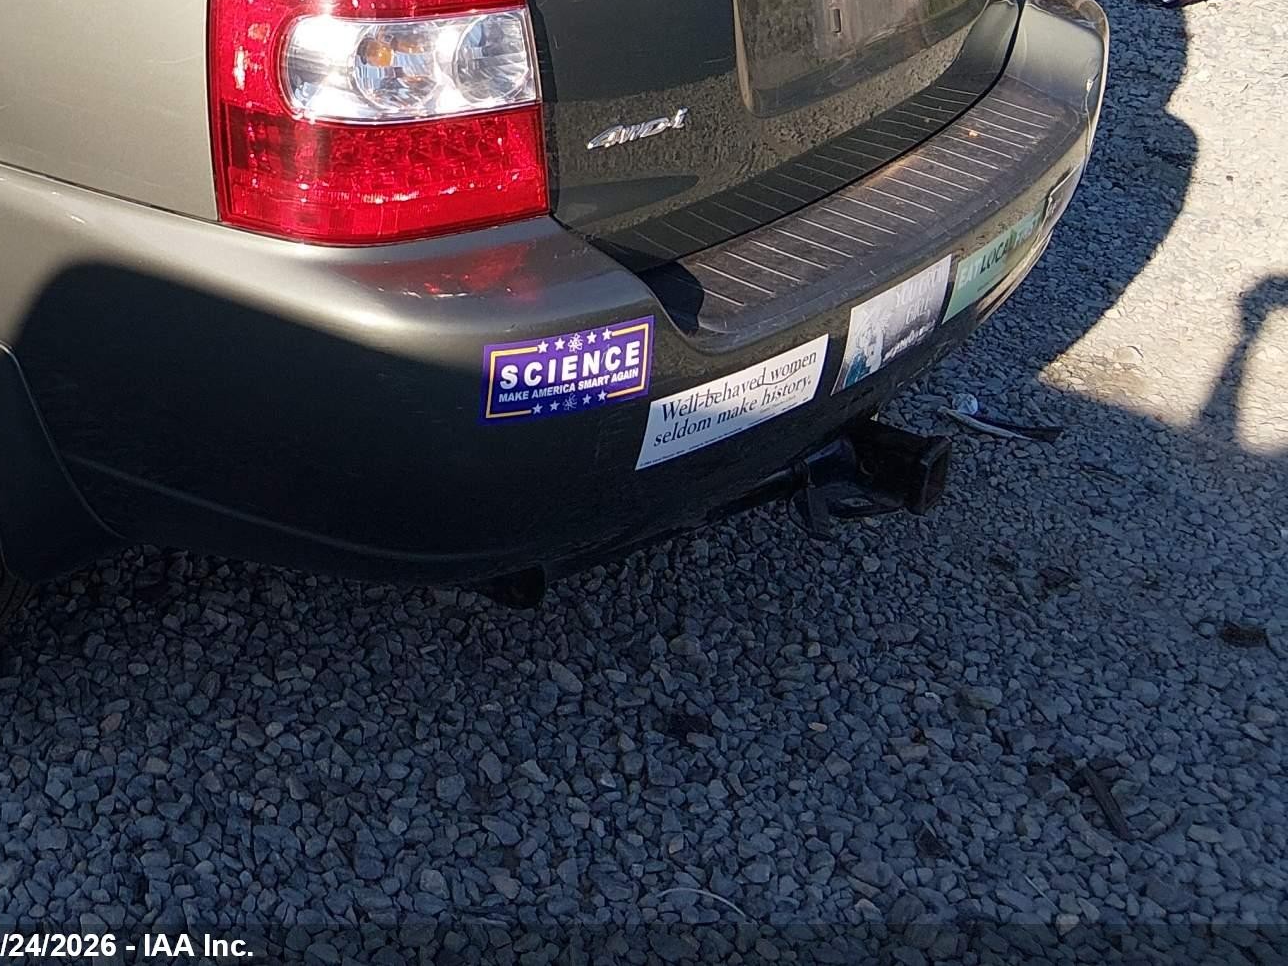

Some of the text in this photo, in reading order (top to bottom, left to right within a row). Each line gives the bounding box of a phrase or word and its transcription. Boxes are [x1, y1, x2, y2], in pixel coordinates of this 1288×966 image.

[957, 256, 981, 291] EAT
[498, 367, 639, 403] MAKE AMERICA SMART AGAIN
[499, 340, 641, 390] SCIENCE
[662, 367, 767, 422] Well-behaved
[770, 352, 817, 383] women
[653, 414, 712, 447] seldom
[716, 397, 759, 425] make
[762, 374, 812, 409] history.
